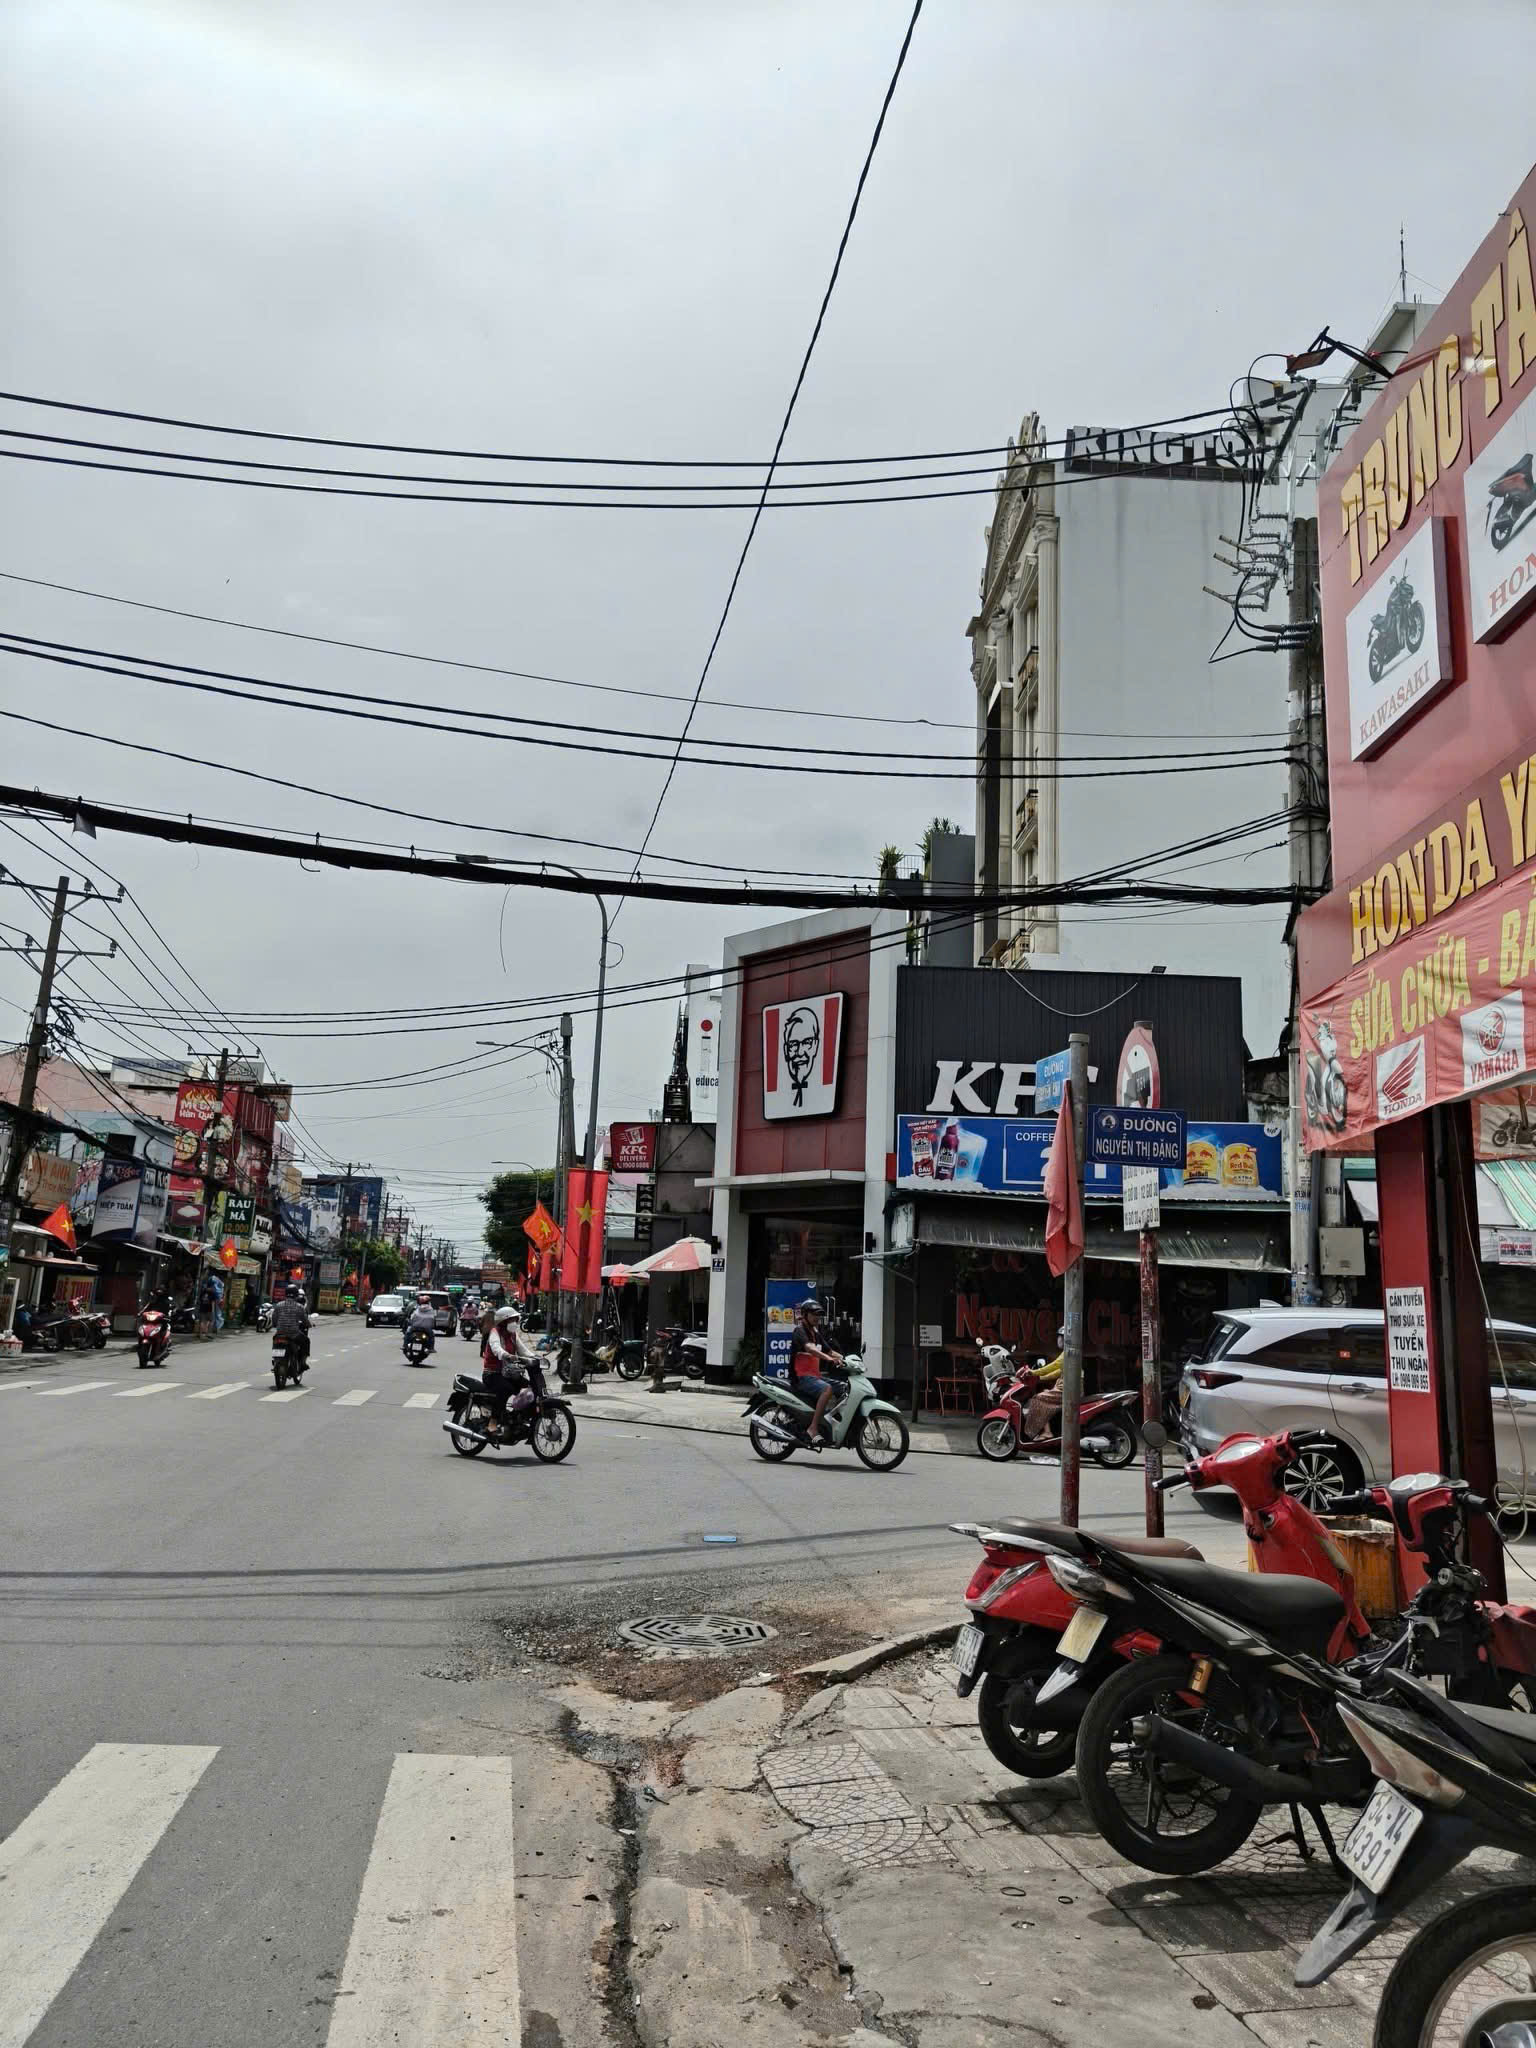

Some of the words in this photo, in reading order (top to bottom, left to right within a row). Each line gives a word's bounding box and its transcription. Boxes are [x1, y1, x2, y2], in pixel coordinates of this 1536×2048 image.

[1341, 334, 1463, 587] TRUNG
[1471, 207, 1536, 417] TÂ
[1360, 660, 1431, 745] KAWASAKI
[1349, 798, 1497, 966] HONDA
[1350, 967, 1395, 1059] SỬA
[1470, 1049, 1519, 1084] YAMAHA
[1384, 1093, 1422, 1116] HONDA
[1123, 1117, 1176, 1133] ĐƯỜNG
[619, 1154, 647, 1162] DELIVERY
[620, 1145, 648, 1155] KFC
[1096, 1133, 1133, 1157] NGUYỄN
[1136, 1140, 1150, 1160] THỊ
[1153, 1139, 1178, 1161] ĐẶNG
[228, 1199, 252, 1209] RAU
[229, 1210, 246, 1222] MÁ
[713, 1259, 725, 1267] 77
[1416, 1314, 1425, 1327] XE
[1393, 1329, 1424, 1351] TUYỂN
[1391, 1356, 1406, 1370] THU
[1408, 1354, 1428, 1372] NGÂN
[1346, 1825, 1391, 1881] 9391
